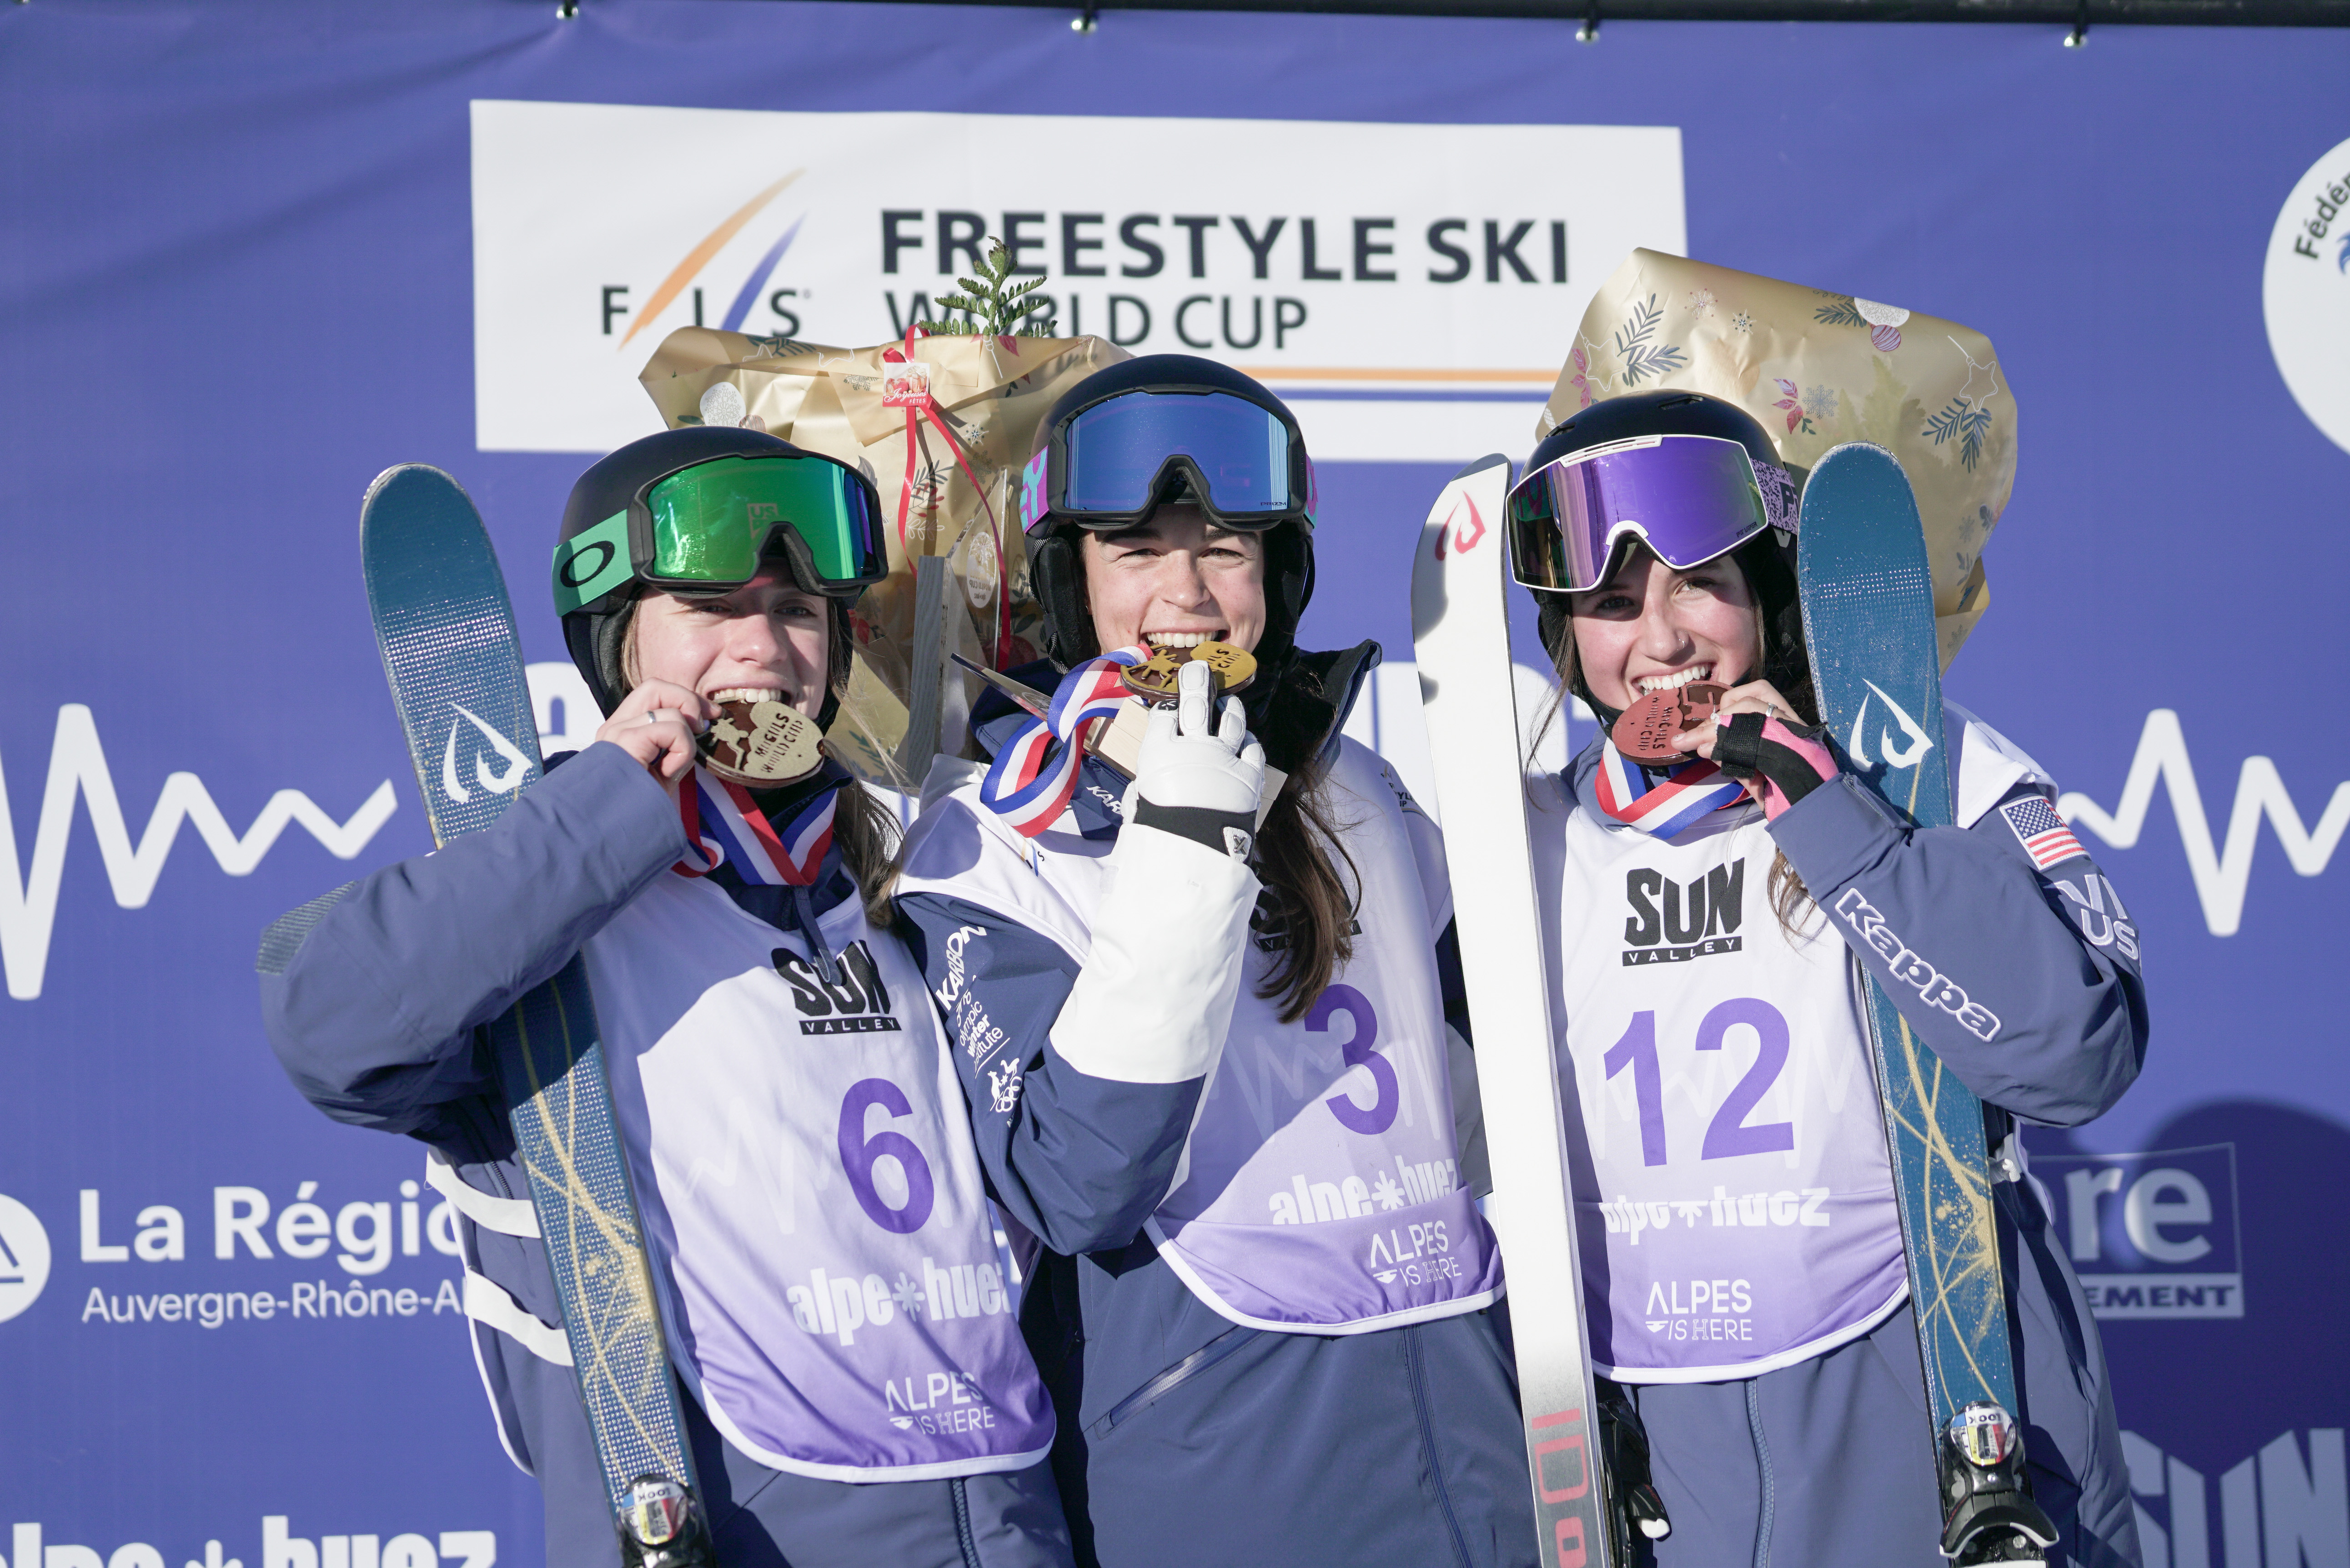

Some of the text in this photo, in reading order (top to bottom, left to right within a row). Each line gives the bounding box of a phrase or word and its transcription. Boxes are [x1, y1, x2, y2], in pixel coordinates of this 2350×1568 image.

[881, 209, 1569, 284] FREESTYLE SKI
[602, 285, 801, 339] FIS
[1175, 293, 1307, 350] CUP
[884, 388, 927, 402] Joyeuses
[1744, 521, 1758, 533] VIPER
[1086, 785, 1122, 815] KAR
[1624, 857, 1745, 947] SUN
[935, 925, 987, 1011] KARBON
[1628, 939, 1734, 963] VALLEY
[1835, 888, 2002, 1042] Kappa
[771, 940, 891, 1017] SUN
[805, 1019, 895, 1033] VALLEY
[960, 1001, 982, 1046] olympic
[967, 1014, 990, 1057] winter
[1305, 984, 1400, 1135] 3
[1603, 997, 1795, 1167] 12
[838, 1078, 934, 1234] 6
[80, 1181, 461, 1275] La Régio
[2045, 1167, 2213, 1264] re
[1370, 1220, 1448, 1268] ALPES
[1400, 1256, 1462, 1287] IS HERE
[786, 1267, 895, 1346] alpe
[1646, 1278, 1752, 1315] ALPES
[2083, 1284, 2235, 1308] EMENT
[1668, 1319, 1752, 1341] IS HERE
[885, 1371, 983, 1412] ALPES
[914, 1406, 995, 1435] IS HERE
[639, 1487, 671, 1502] LOOK
